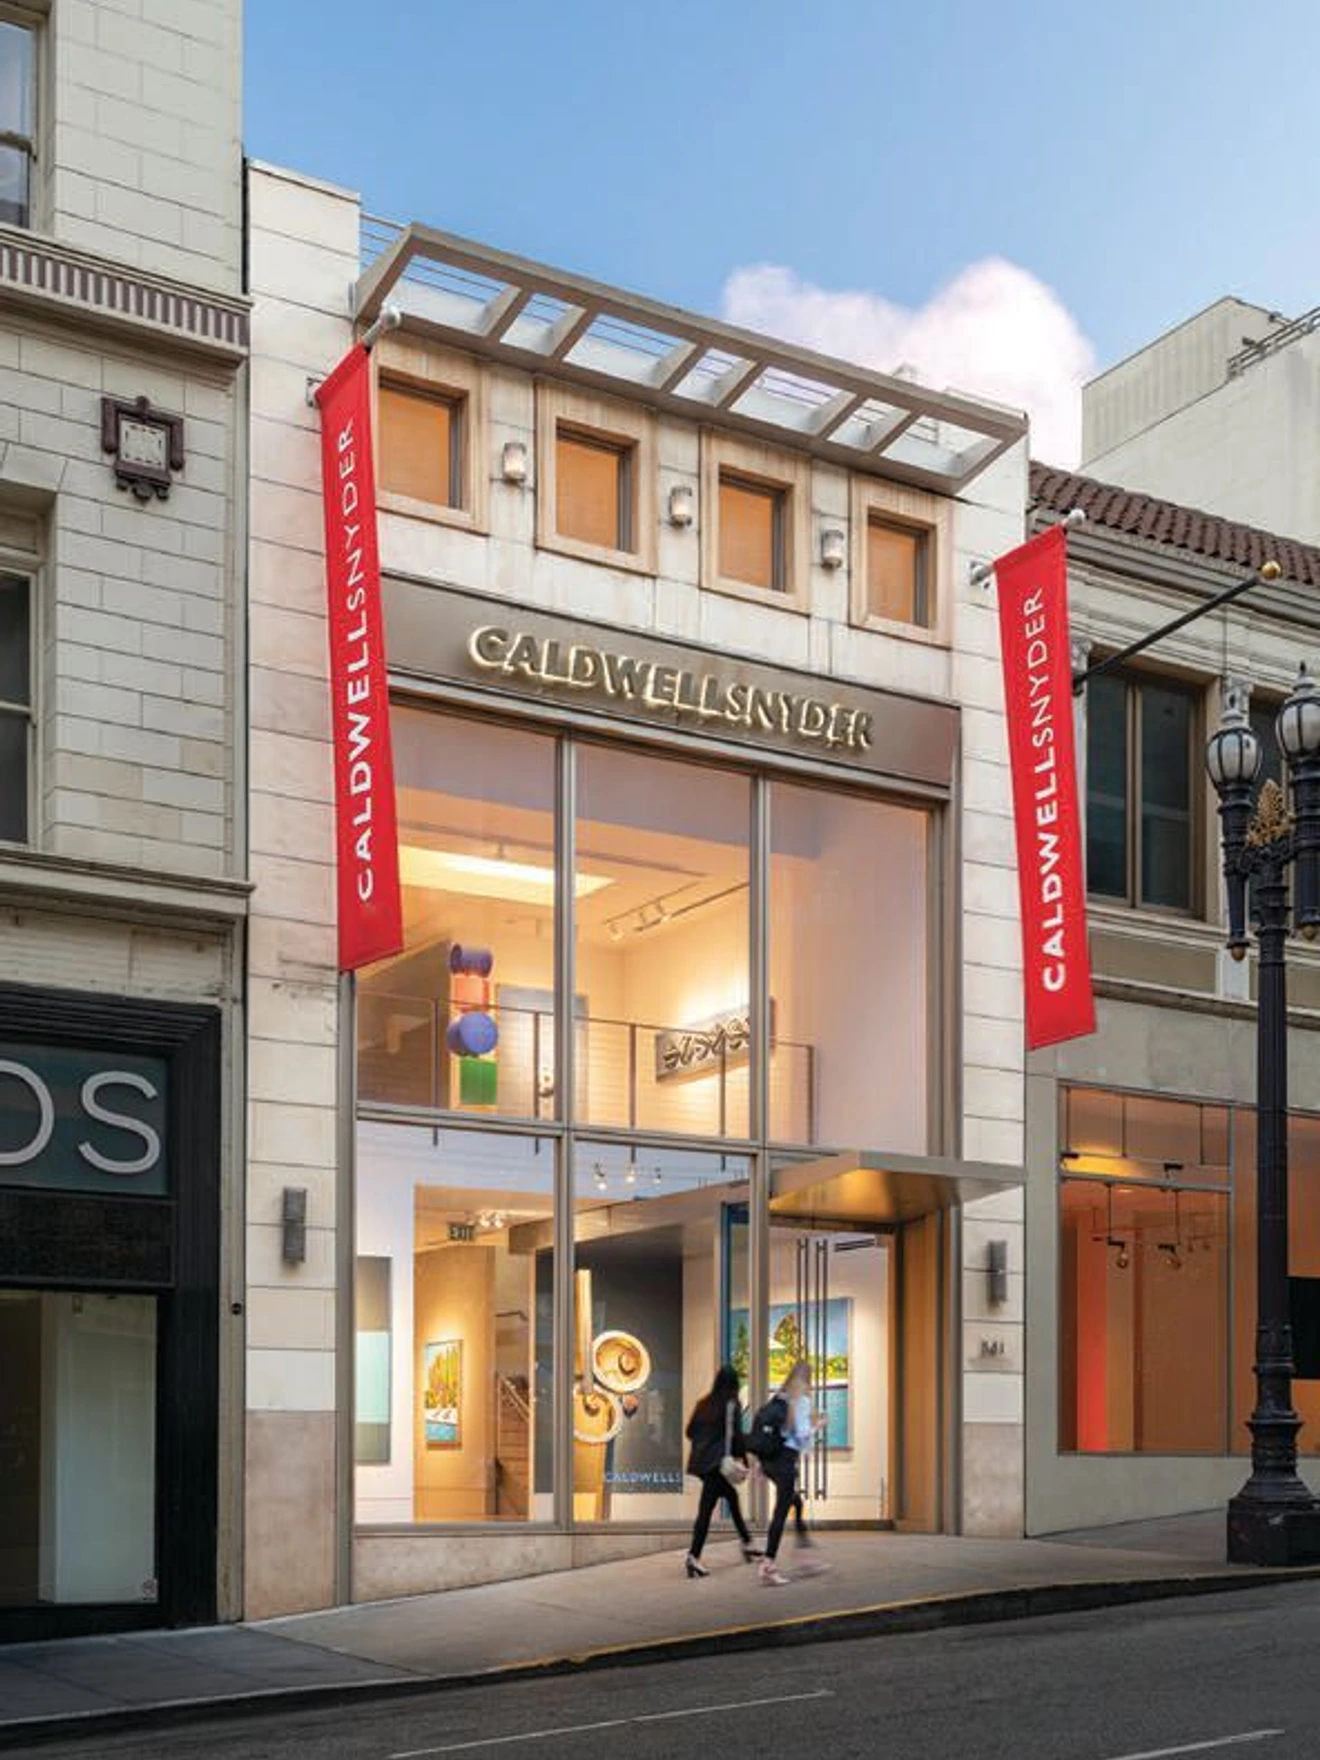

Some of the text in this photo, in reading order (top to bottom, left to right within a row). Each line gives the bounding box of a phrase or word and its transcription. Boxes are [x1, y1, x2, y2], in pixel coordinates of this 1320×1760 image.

[338, 420, 374, 902] CALDWELLSNYDER
[468, 625, 874, 749] CALDWELLSNYDER
[1024, 588, 1066, 992] CALDWELLSNYDER
